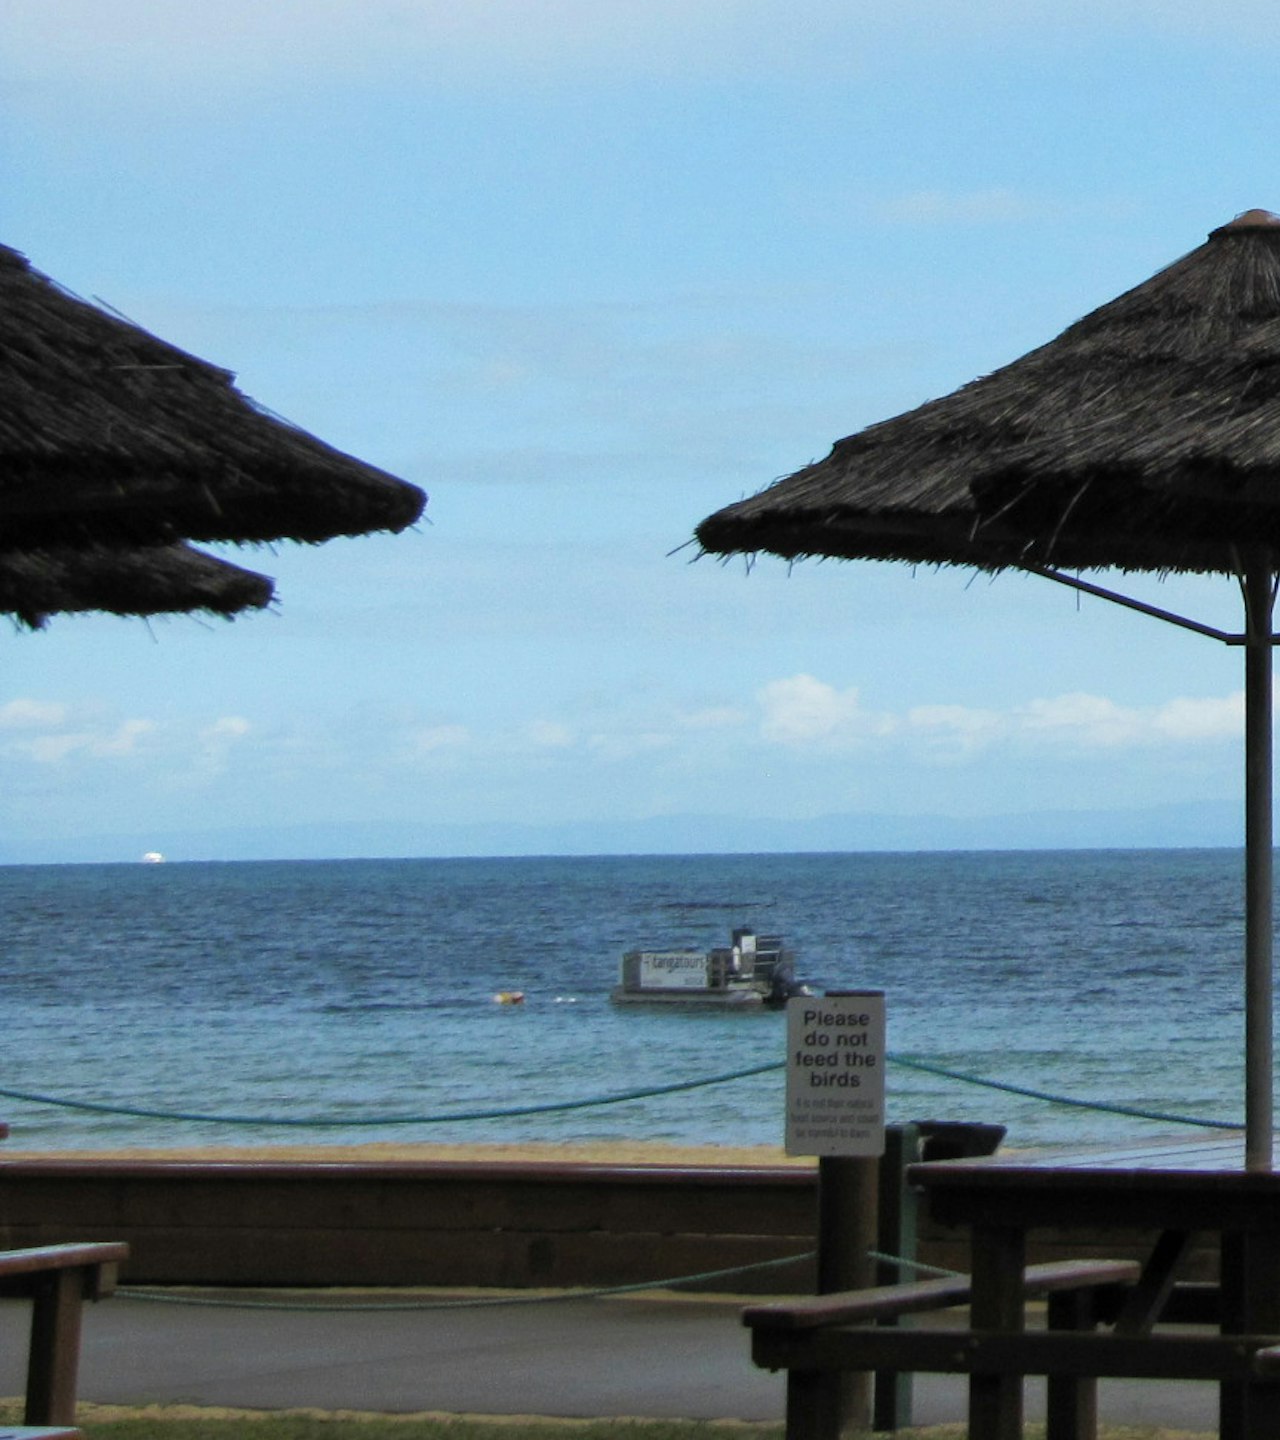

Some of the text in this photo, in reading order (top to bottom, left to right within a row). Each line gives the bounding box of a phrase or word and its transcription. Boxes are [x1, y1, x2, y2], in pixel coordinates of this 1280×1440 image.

[804, 1010, 870, 1026] Please
[804, 1030, 868, 1047] do not
[796, 1050, 876, 1067] feed the
[811, 1071, 861, 1087] birds
